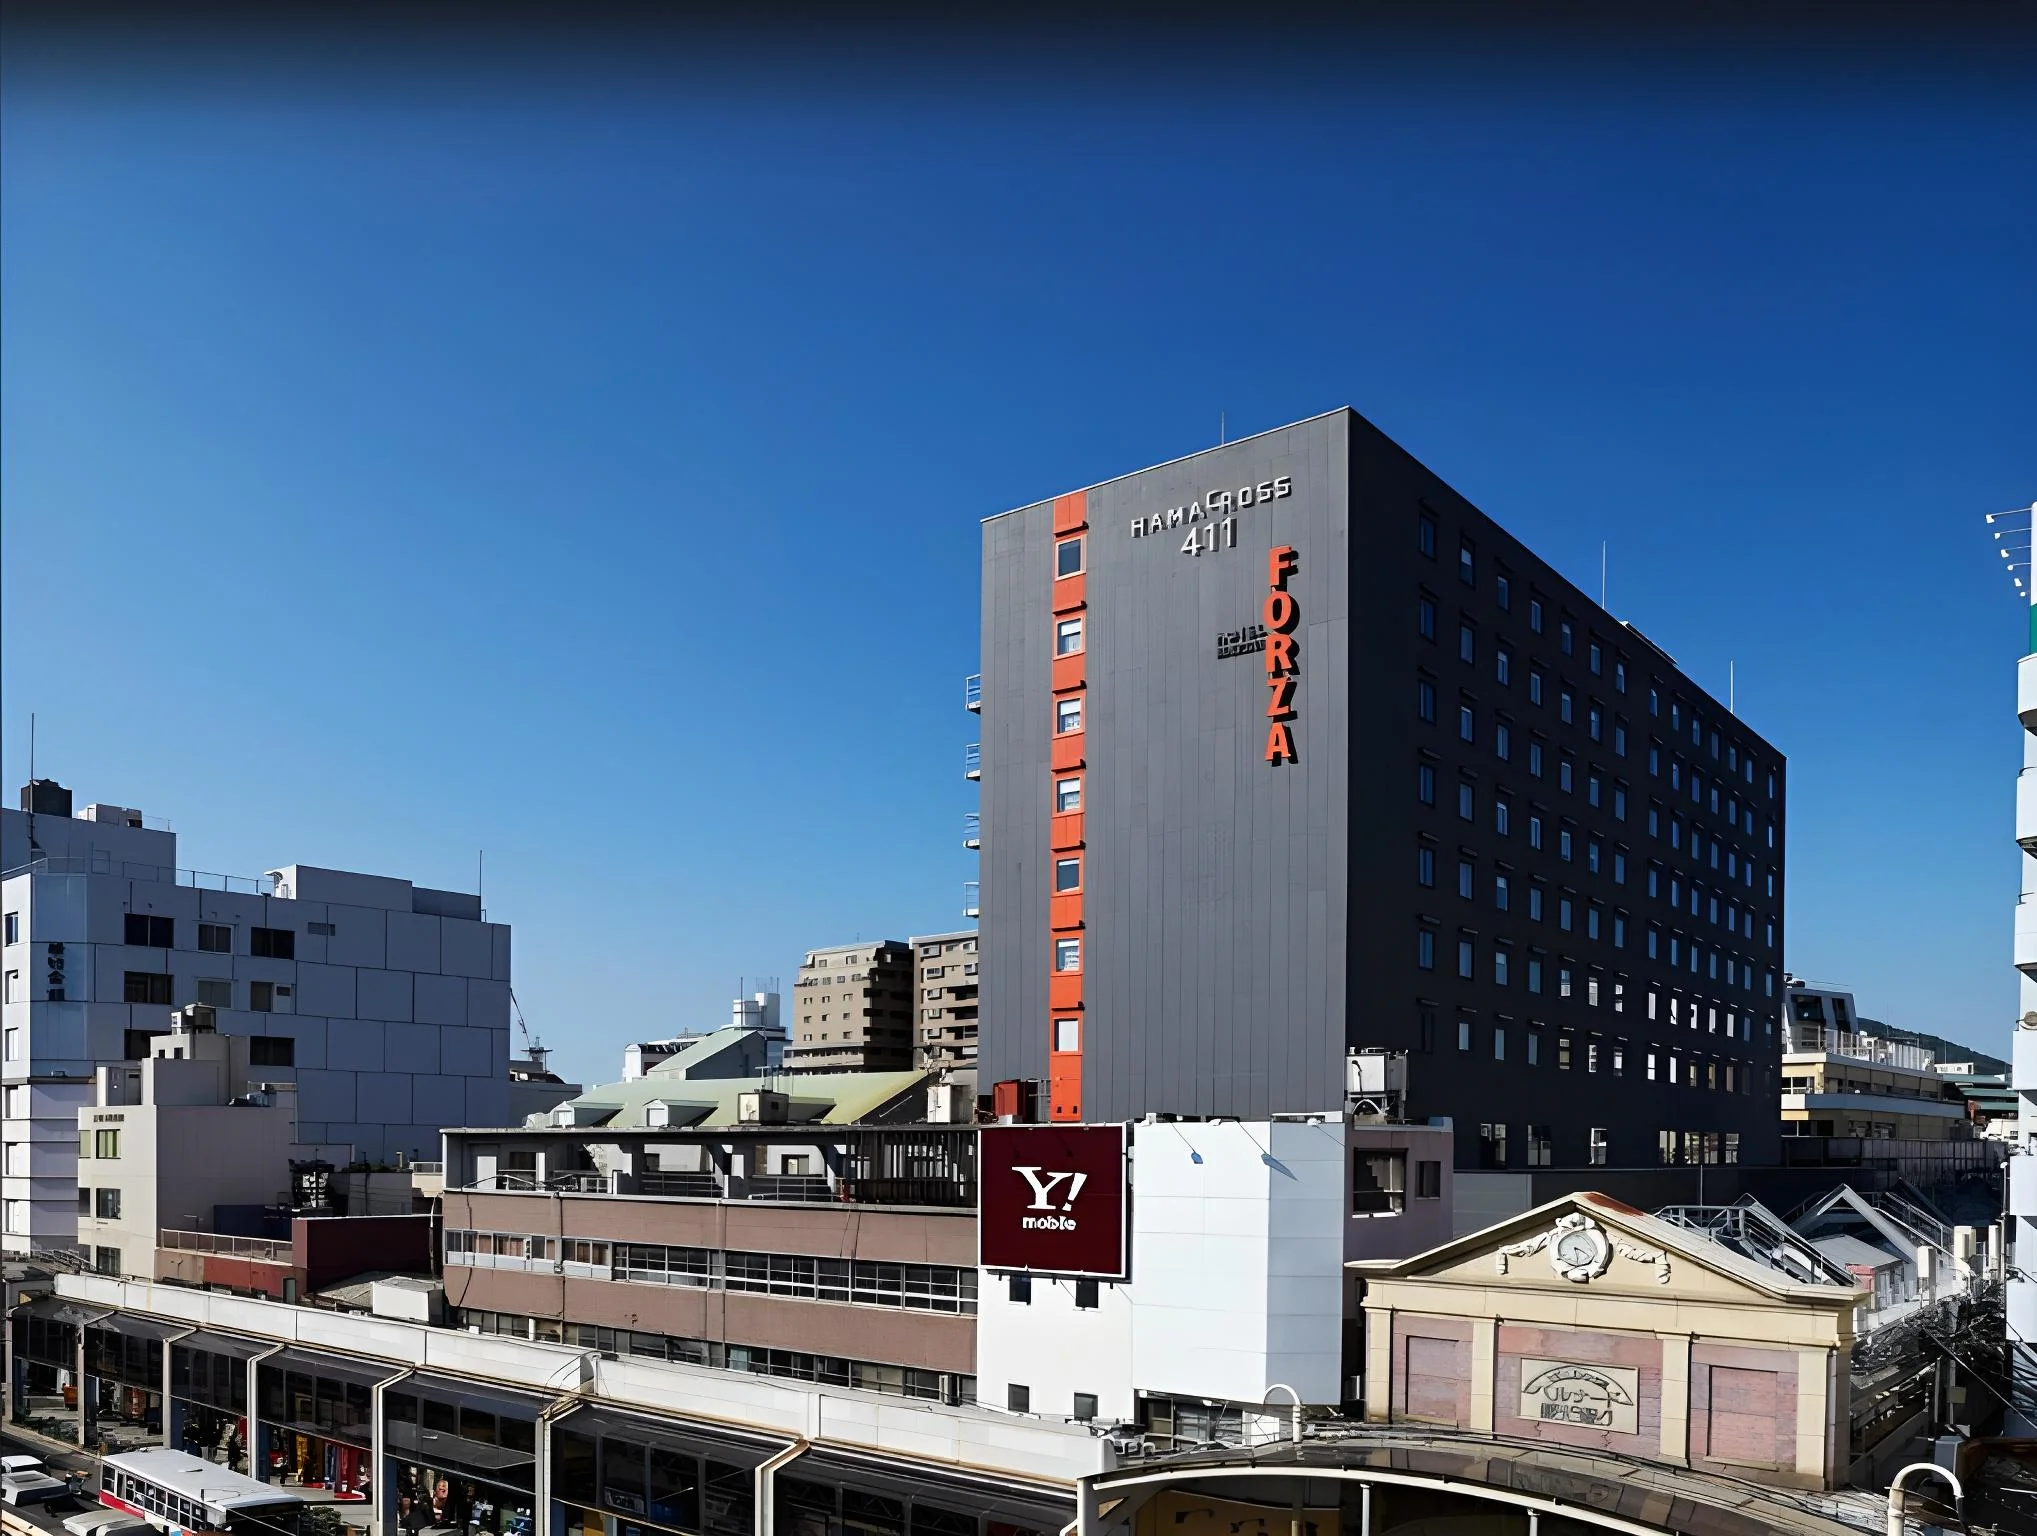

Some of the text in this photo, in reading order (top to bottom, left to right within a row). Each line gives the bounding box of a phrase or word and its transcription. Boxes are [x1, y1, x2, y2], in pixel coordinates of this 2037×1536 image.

[1131, 476, 1292, 538] HAMACROSS
[1180, 516, 1237, 557] 411
[1263, 544, 1297, 764] FORZA
[1011, 1166, 1088, 1212] Y!
